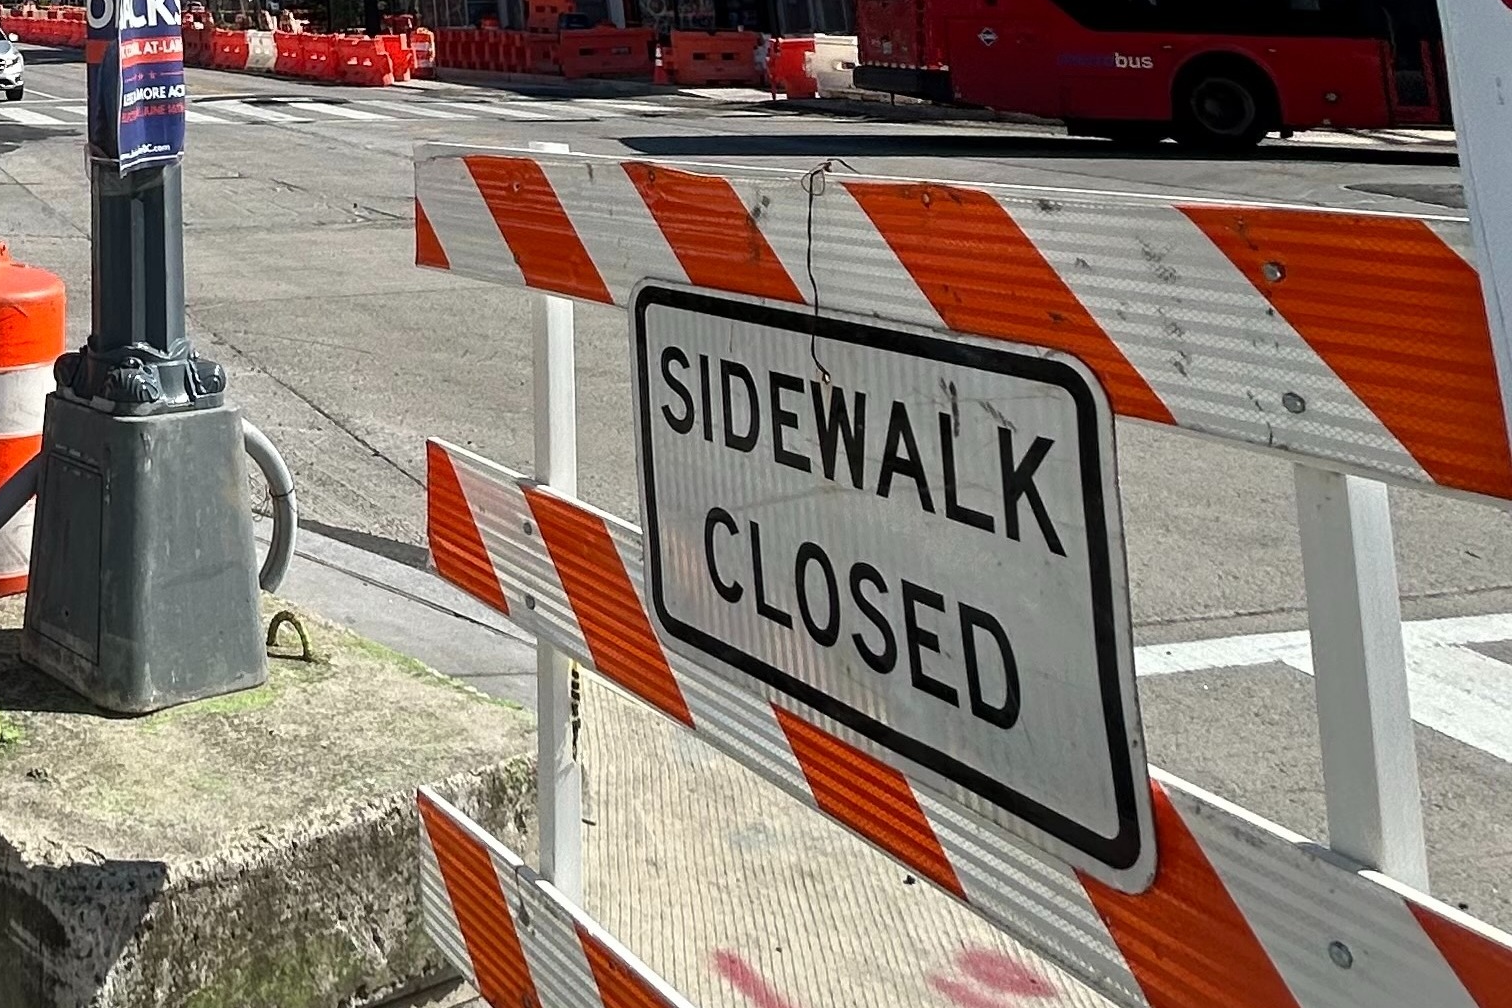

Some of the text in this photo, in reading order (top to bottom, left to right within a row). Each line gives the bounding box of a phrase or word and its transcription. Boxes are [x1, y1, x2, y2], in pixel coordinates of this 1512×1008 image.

[136, 85, 166, 101] MORE
[660, 345, 1068, 558] SIDEWALK
[704, 506, 1022, 731] CLOSED
